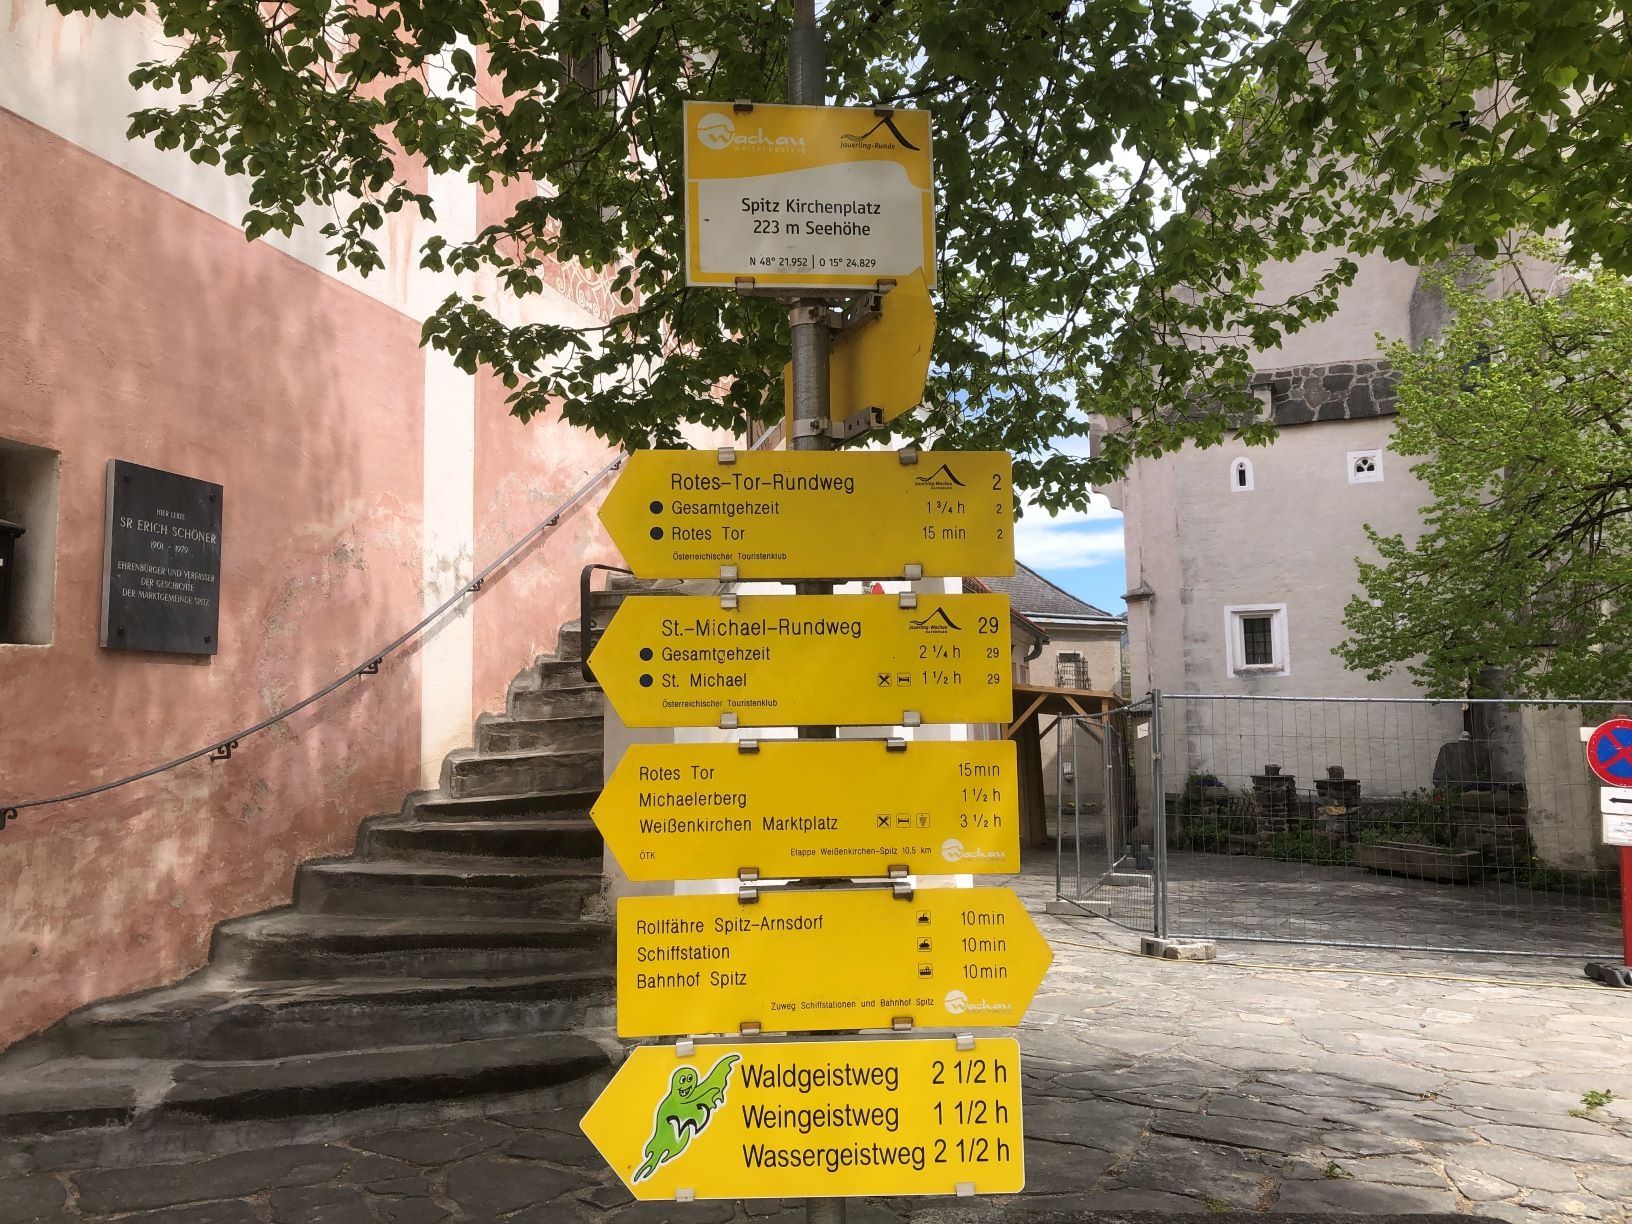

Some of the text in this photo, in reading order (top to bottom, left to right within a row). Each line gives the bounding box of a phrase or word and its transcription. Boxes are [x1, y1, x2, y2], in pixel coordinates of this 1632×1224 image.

[741, 198, 881, 217] Spitz Kirchenplatz
[753, 220, 871, 236] 223 m Seehöhe
[750, 257, 757, 266] N
[759, 257, 776, 266] 48°
[779, 257, 808, 267] 21.952
[829, 258, 843, 267] 15°
[846, 258, 876, 267] 24.829
[671, 473, 1001, 494] Rotes-Tor-Rundweg 2
[156, 509, 169, 518] HIER
[672, 500, 780, 518] Gesamtgehzeit
[926, 500, 931, 514] 1
[957, 500, 965, 514] h
[996, 503, 1002, 514] 2
[120, 516, 217, 544] SR ERICH SCHÖNER
[672, 525, 1003, 541] Rotes Tor 15 min 2
[150, 540, 164, 551] 1901
[175, 544, 189, 554] 1979
[672, 551, 787, 560] Österreichischer Touristenklub
[117, 561, 215, 583] EHRENBÜRGER UND VERFASSER
[140, 577, 195, 593] DER GESCHICHTE
[122, 588, 211, 607] DER MARKTGEMEINDE SPITZ
[661, 616, 999, 639] St.-Michael-Rundweg 29
[661, 646, 770, 664] Gesamtgehzeit
[919, 645, 927, 659] 2
[952, 645, 960, 659] h
[986, 648, 999, 658] 29
[661, 673, 680, 688] St.
[690, 673, 747, 687] Michael
[922, 670, 927, 685] 1
[953, 670, 961, 684] h
[987, 673, 1000, 684] 29
[662, 698, 778, 708] Österreichischer Touristenklub
[639, 766, 681, 781] Rotes
[691, 765, 714, 780] Tor
[639, 791, 747, 809] Michaelerberg
[962, 788, 967, 802] 1
[992, 788, 1001, 802] h
[639, 817, 752, 834] Weißenkirchen
[763, 816, 838, 833] Marktplatz
[960, 814, 968, 828] 3
[993, 814, 1001, 828] h
[639, 849, 656, 860] ÖTK
[790, 848, 816, 857] Etappe
[820, 846, 897, 856] Weißenkirchen-Spitz
[920, 846, 932, 854] km
[637, 920, 704, 935] Rollfähre
[714, 915, 824, 935] Spitz-Arnsdorf
[637, 945, 730, 962] Schiffstation
[637, 972, 700, 989] Bahnhof
[710, 970, 747, 988] Spitz
[771, 998, 934, 1011] Zuweg Schiffstationen und Bahnhof Spitz
[741, 1059, 1007, 1094] Waldgeistweg 2 1/2 h
[742, 1100, 1008, 1134] Weingeistweg 1 1/2 h
[742, 1137, 1010, 1173] Wassergeistweg 2 1/2 h
